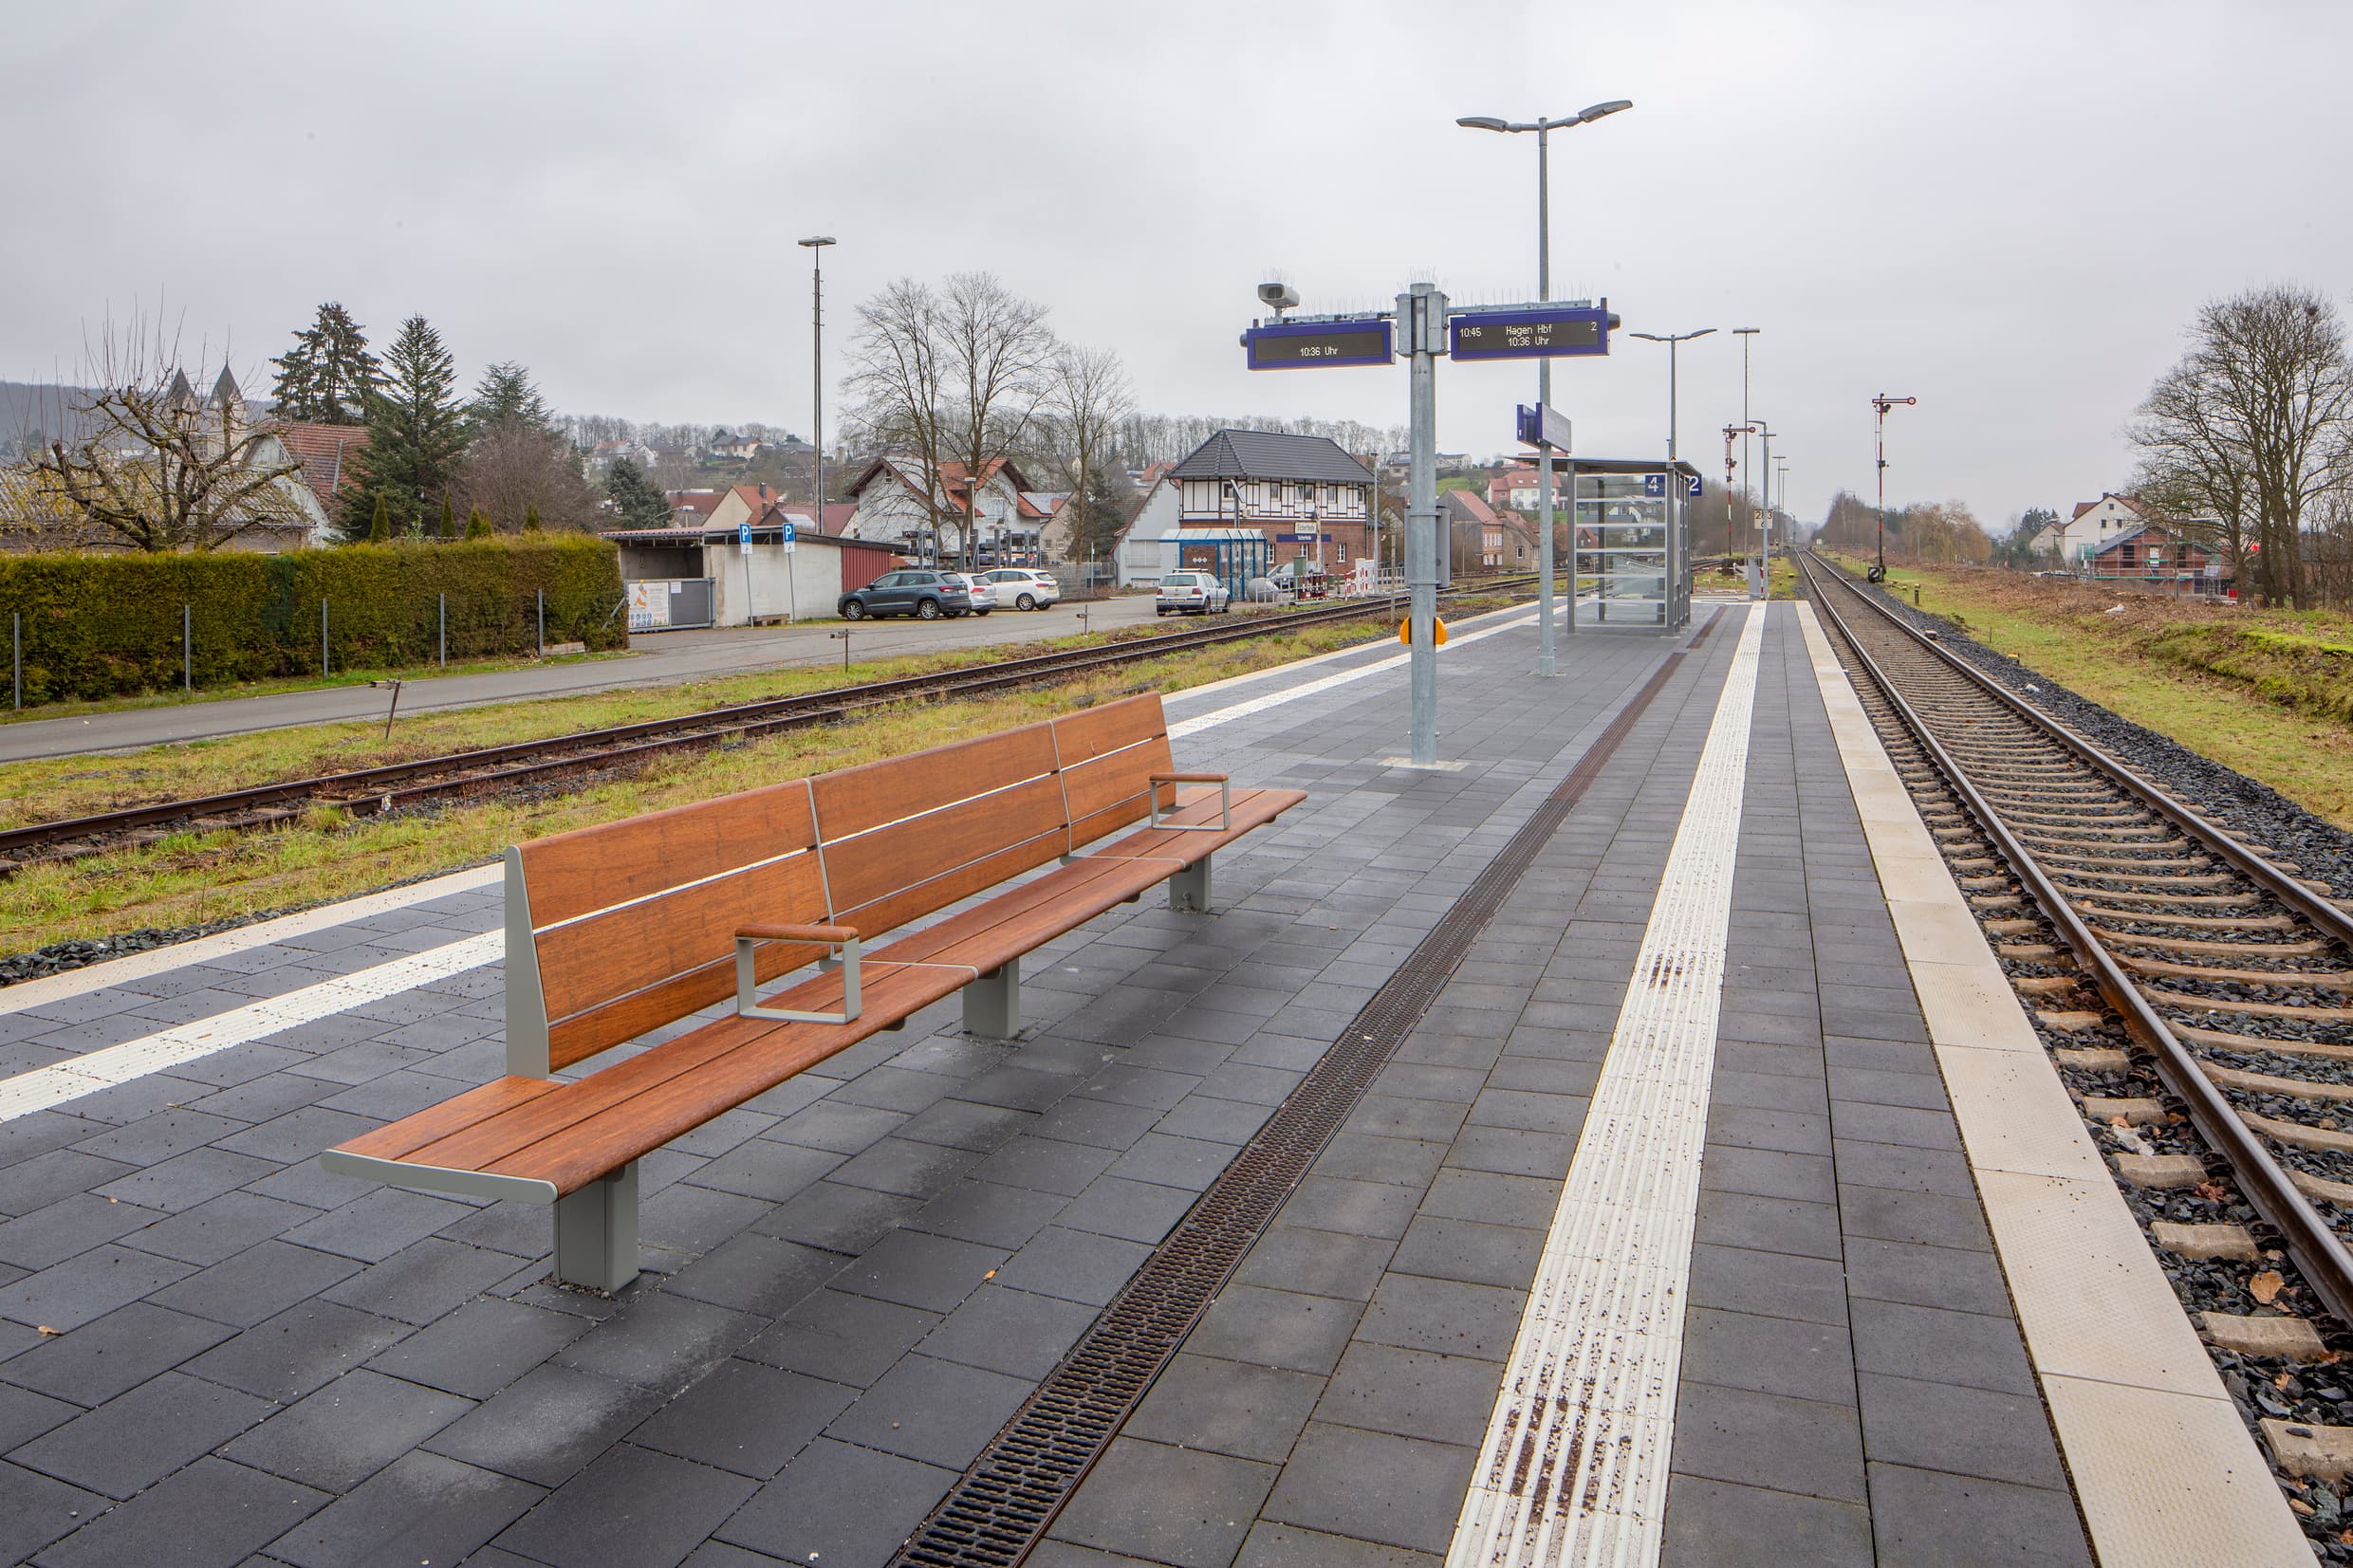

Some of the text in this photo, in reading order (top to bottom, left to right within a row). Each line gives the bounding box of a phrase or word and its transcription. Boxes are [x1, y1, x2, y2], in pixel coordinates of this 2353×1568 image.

[1459, 321, 1598, 338] 10:45 Hagen Hbf 2
[1508, 336, 1550, 347] 10:36 Uhr
[1300, 345, 1338, 357] 10:36 Uhr
[1648, 476, 1659, 492] 4
[1689, 475, 1700, 491] 2
[742, 526, 750, 542] P
[785, 526, 792, 541] P
